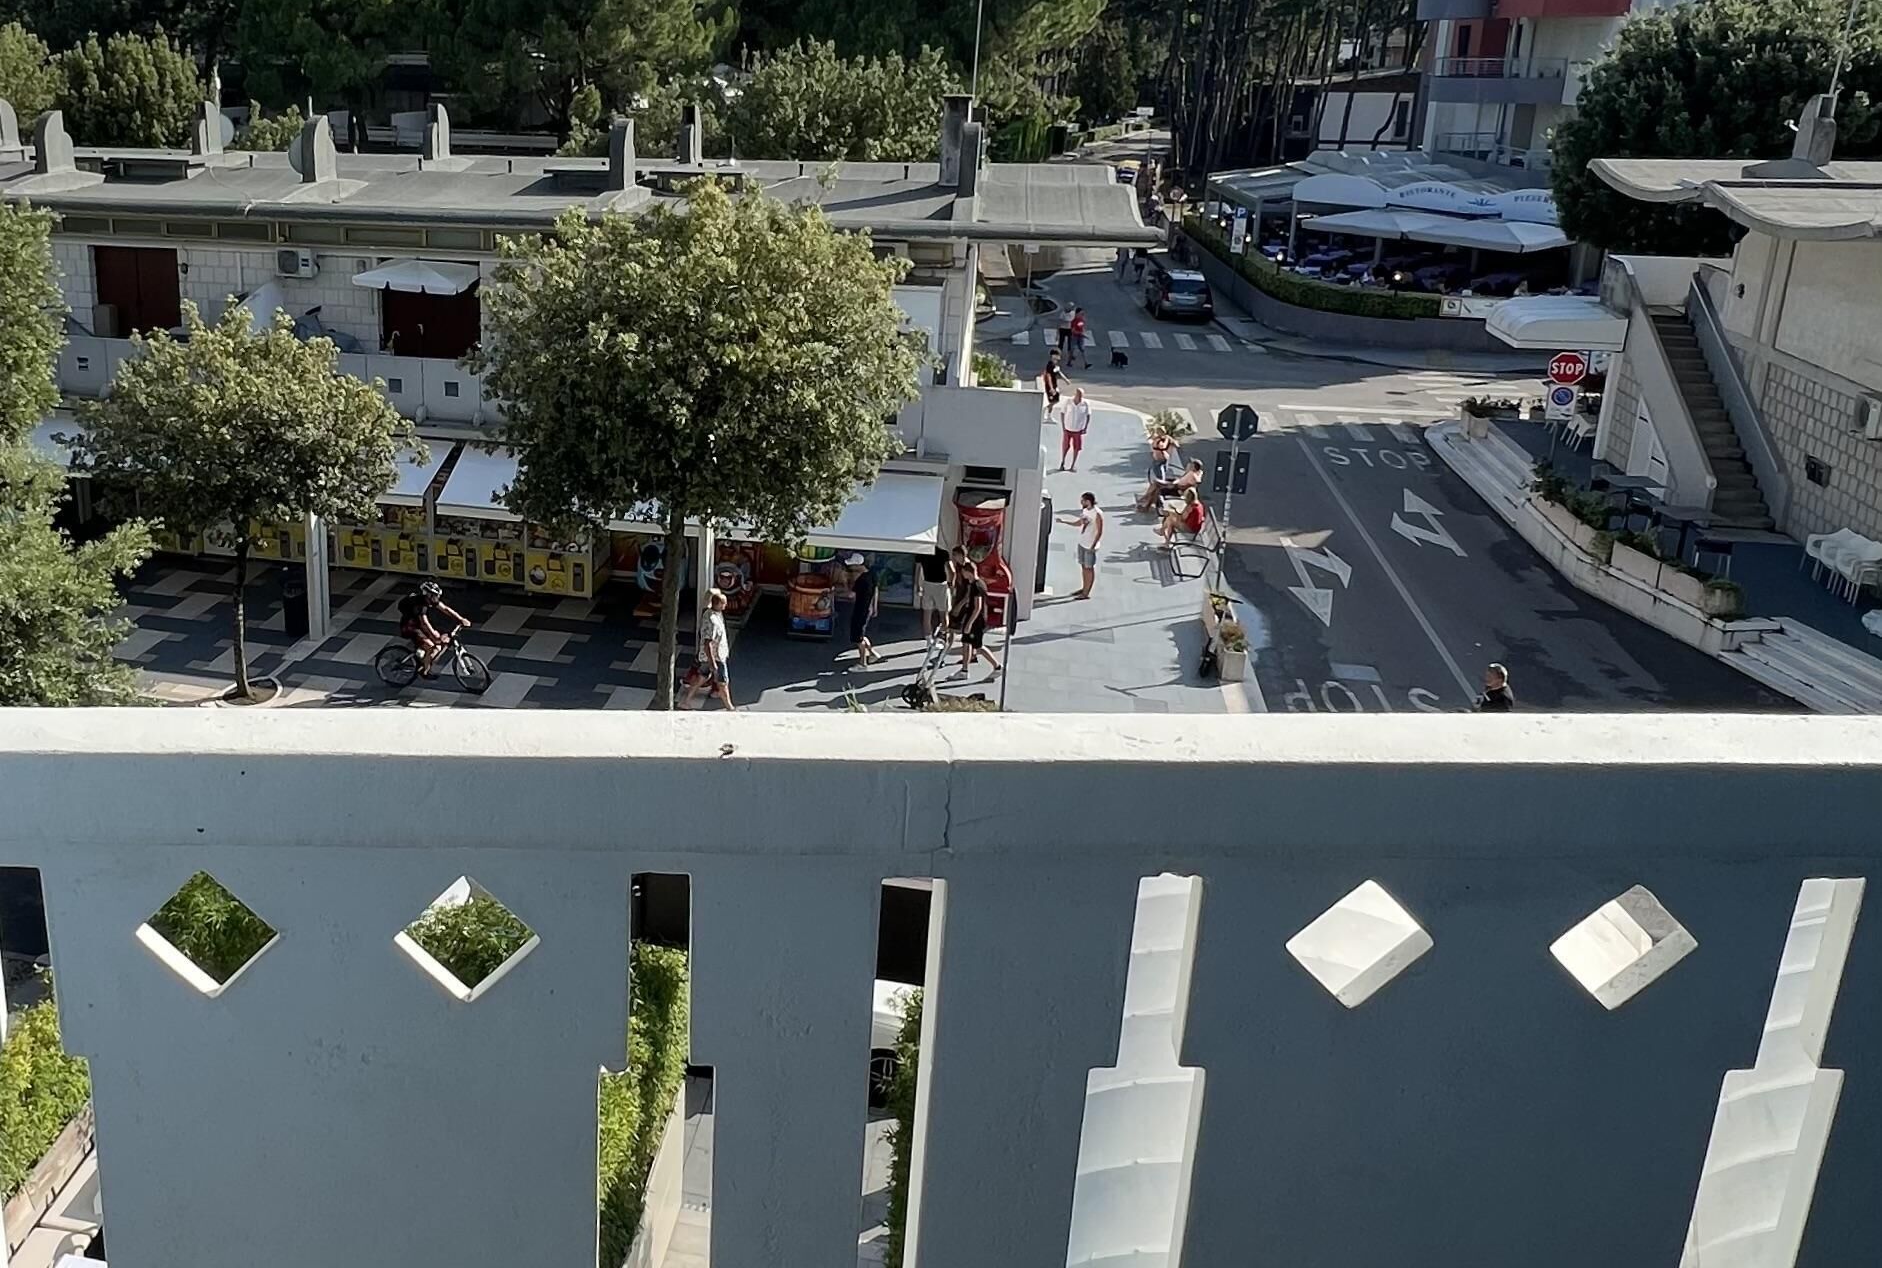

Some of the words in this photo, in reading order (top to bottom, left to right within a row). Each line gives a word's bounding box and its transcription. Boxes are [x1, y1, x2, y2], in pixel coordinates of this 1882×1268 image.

[1399, 187, 1456, 198] RISTORANTE
[1513, 195, 1553, 204] PIZZER
[1237, 207, 1246, 217] P
[1551, 361, 1584, 376] STOP
[1323, 446, 1432, 471] STOP
